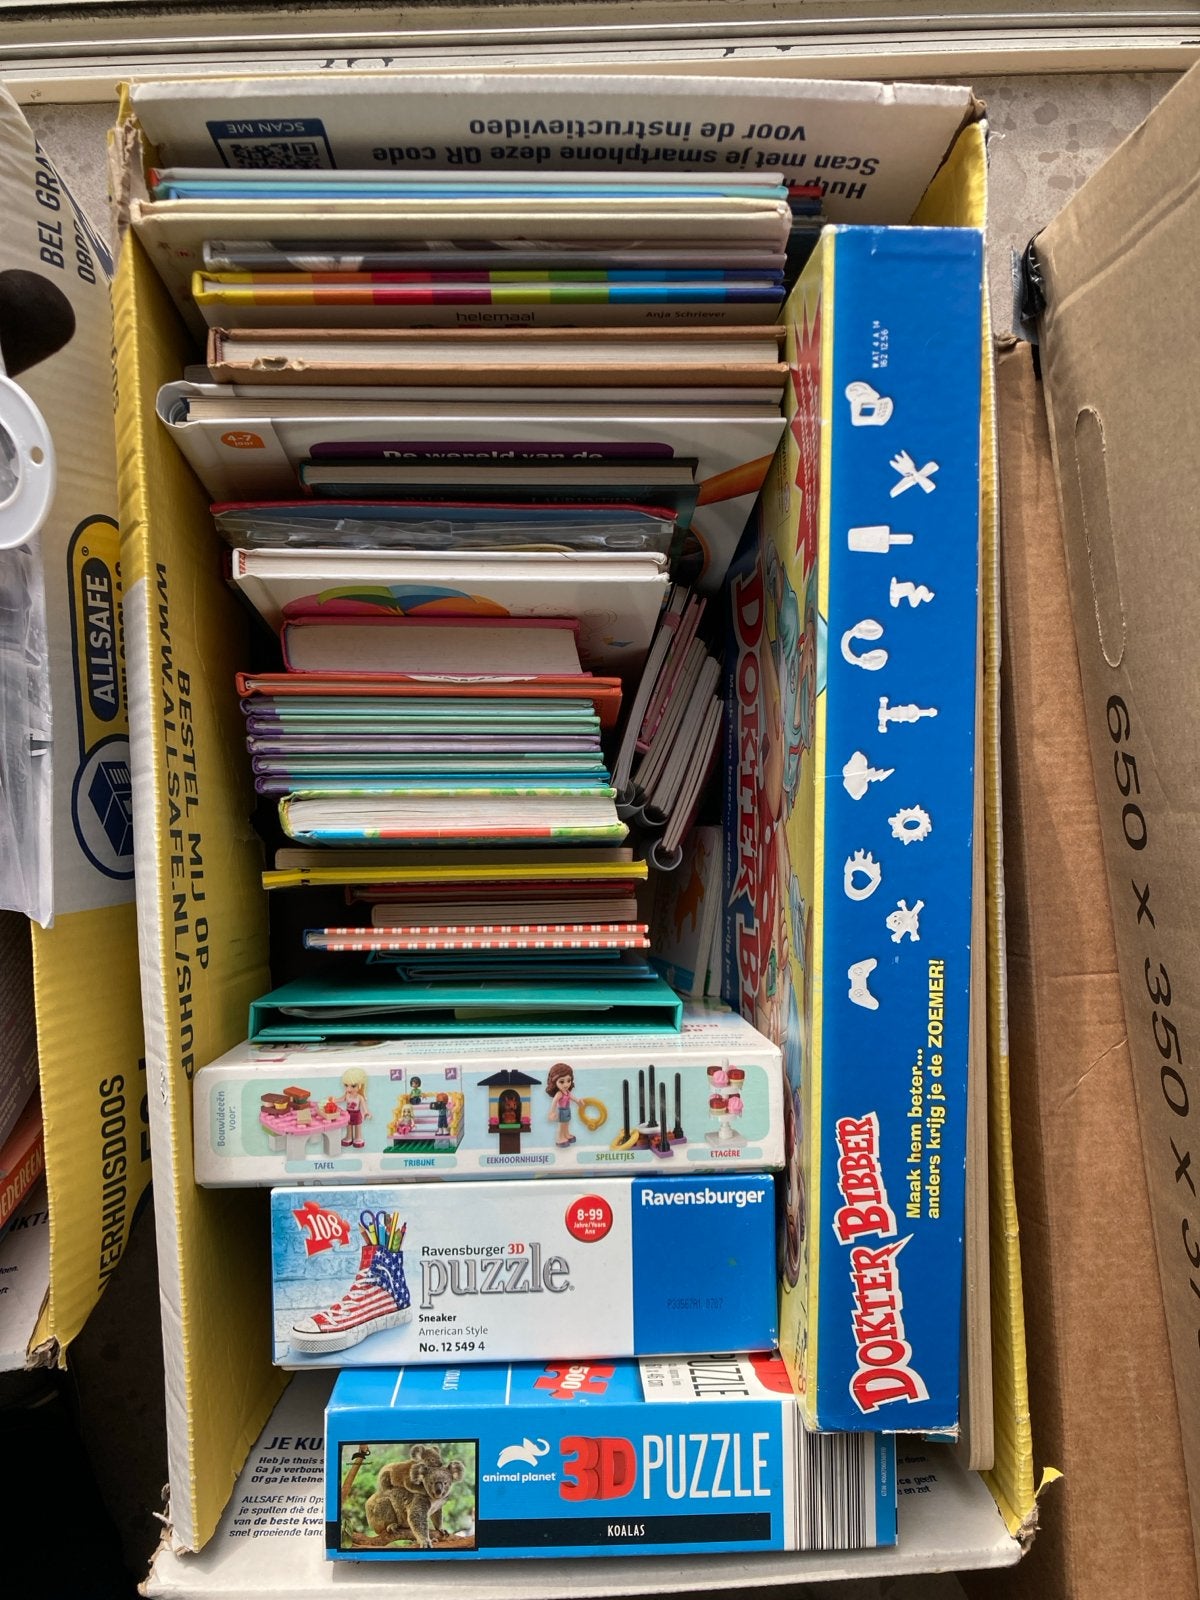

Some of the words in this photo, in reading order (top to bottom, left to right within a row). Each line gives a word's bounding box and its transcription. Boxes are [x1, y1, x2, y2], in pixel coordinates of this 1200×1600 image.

[227, 123, 248, 135] ME
[259, 122, 305, 134] SCAN
[469, 118, 692, 142] instructievideo
[701, 121, 735, 142] de
[741, 122, 806, 142] voor
[372, 146, 436, 166] code
[447, 146, 482, 165] QR
[490, 146, 550, 165] deze
[560, 145, 718, 165] smartphone
[726, 149, 750, 170] je
[755, 150, 805, 168] met
[814, 154, 880, 176] Scan
[37, 220, 65, 269] BEL
[456, 312, 536, 322] helemaal
[645, 310, 673, 319] Anja
[675, 309, 727, 319] Schriever
[227, 434, 252, 442] 4-7
[86, 574, 116, 705] ALLSAFE
[732, 555, 765, 905] DOKTER
[177, 669, 199, 818] BESTEL
[187, 833, 206, 901] MIJ
[194, 917, 209, 970] OP
[1107, 693, 1149, 852] 650
[1131, 878, 1156, 930] x
[1144, 956, 1190, 1119] 350
[1168, 1137, 1197, 1197] x
[927, 959, 946, 1049] ZOEMER!
[927, 1054, 943, 1078] de
[907, 1048, 924, 1118] beter...
[927, 1082, 946, 1101] je
[217, 1090, 226, 1148] Bouwideeën
[229, 1105, 237, 1132] voor:
[926, 1105, 946, 1149] krijg
[907, 1123, 922, 1165] hem
[313, 1162, 335, 1171] TAFEL
[403, 1158, 436, 1167] TRIBUNE
[486, 1155, 550, 1165] EEKHOORNHUISJE
[595, 1152, 635, 1162] SPELLETJES
[97, 1074, 128, 1293] VERHUISDOOS
[835, 1114, 891, 1242] BIBBER
[926, 1154, 941, 1219] anders
[640, 1188, 766, 1208] Ravensburger
[906, 1168, 922, 1219] Maak
[576, 1208, 604, 1221] 8-99
[306, 1212, 343, 1242] 108
[421, 1244, 505, 1257] Ravensburger
[507, 1243, 525, 1255] 3D
[419, 1242, 570, 1310] puzzle
[418, 1314, 457, 1323] Sneaker
[851, 1240, 920, 1412] DOKTER
[418, 1326, 464, 1336] American
[465, 1325, 489, 1337] Style
[418, 1342, 439, 1353] No.
[441, 1342, 452, 1352] 12
[454, 1342, 475, 1352] 549
[478, 1342, 486, 1351] 4
[560, 1366, 590, 1391] 500
[264, 1437, 292, 1451] JE
[294, 1437, 325, 1451] KU
[270, 1466, 281, 1474] je
[280, 1457, 291, 1466] je
[292, 1457, 318, 1465] thuis
[559, 1435, 637, 1502] 3D
[642, 1432, 771, 1500] PUZZLE
[251, 1475, 264, 1483] Of
[265, 1476, 278, 1484] ga
[279, 1476, 290, 1484] je
[290, 1475, 324, 1483] kleine
[482, 1472, 521, 1483] animal
[521, 1471, 556, 1483] planet
[241, 1495, 284, 1503] ALLSAFE
[286, 1495, 307, 1503] Mini
[239, 1506, 250, 1516] je
[251, 1506, 287, 1516] spullen
[307, 1506, 319, 1514] de
[254, 1517, 267, 1525] de
[269, 1517, 300, 1525] beste
[229, 1528, 251, 1537] snel
[253, 1528, 301, 1539] groeiende
[607, 1524, 645, 1537] KOALAS
